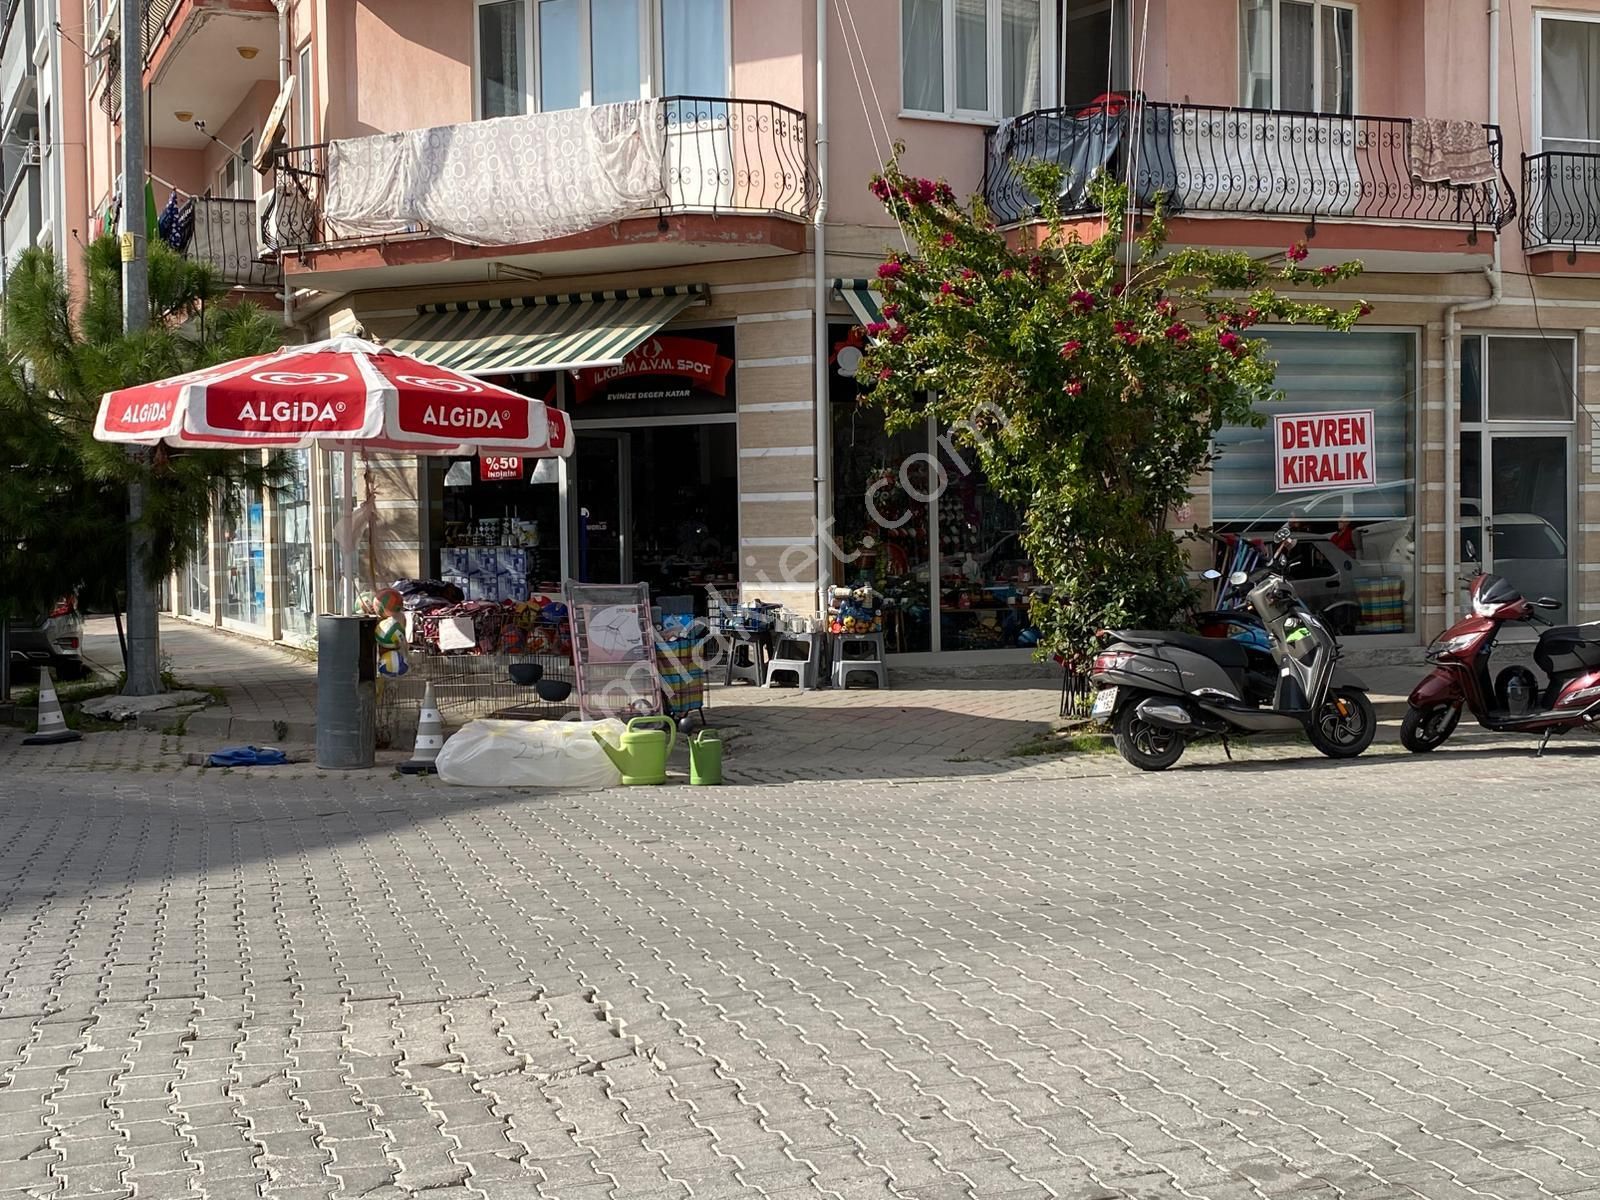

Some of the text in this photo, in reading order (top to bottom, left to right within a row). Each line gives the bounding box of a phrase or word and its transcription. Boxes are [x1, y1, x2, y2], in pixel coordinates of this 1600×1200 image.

[677, 359, 711, 375] SPOT
[1282, 417, 1366, 449] DEVREN
[485, 456, 518, 470] %50
